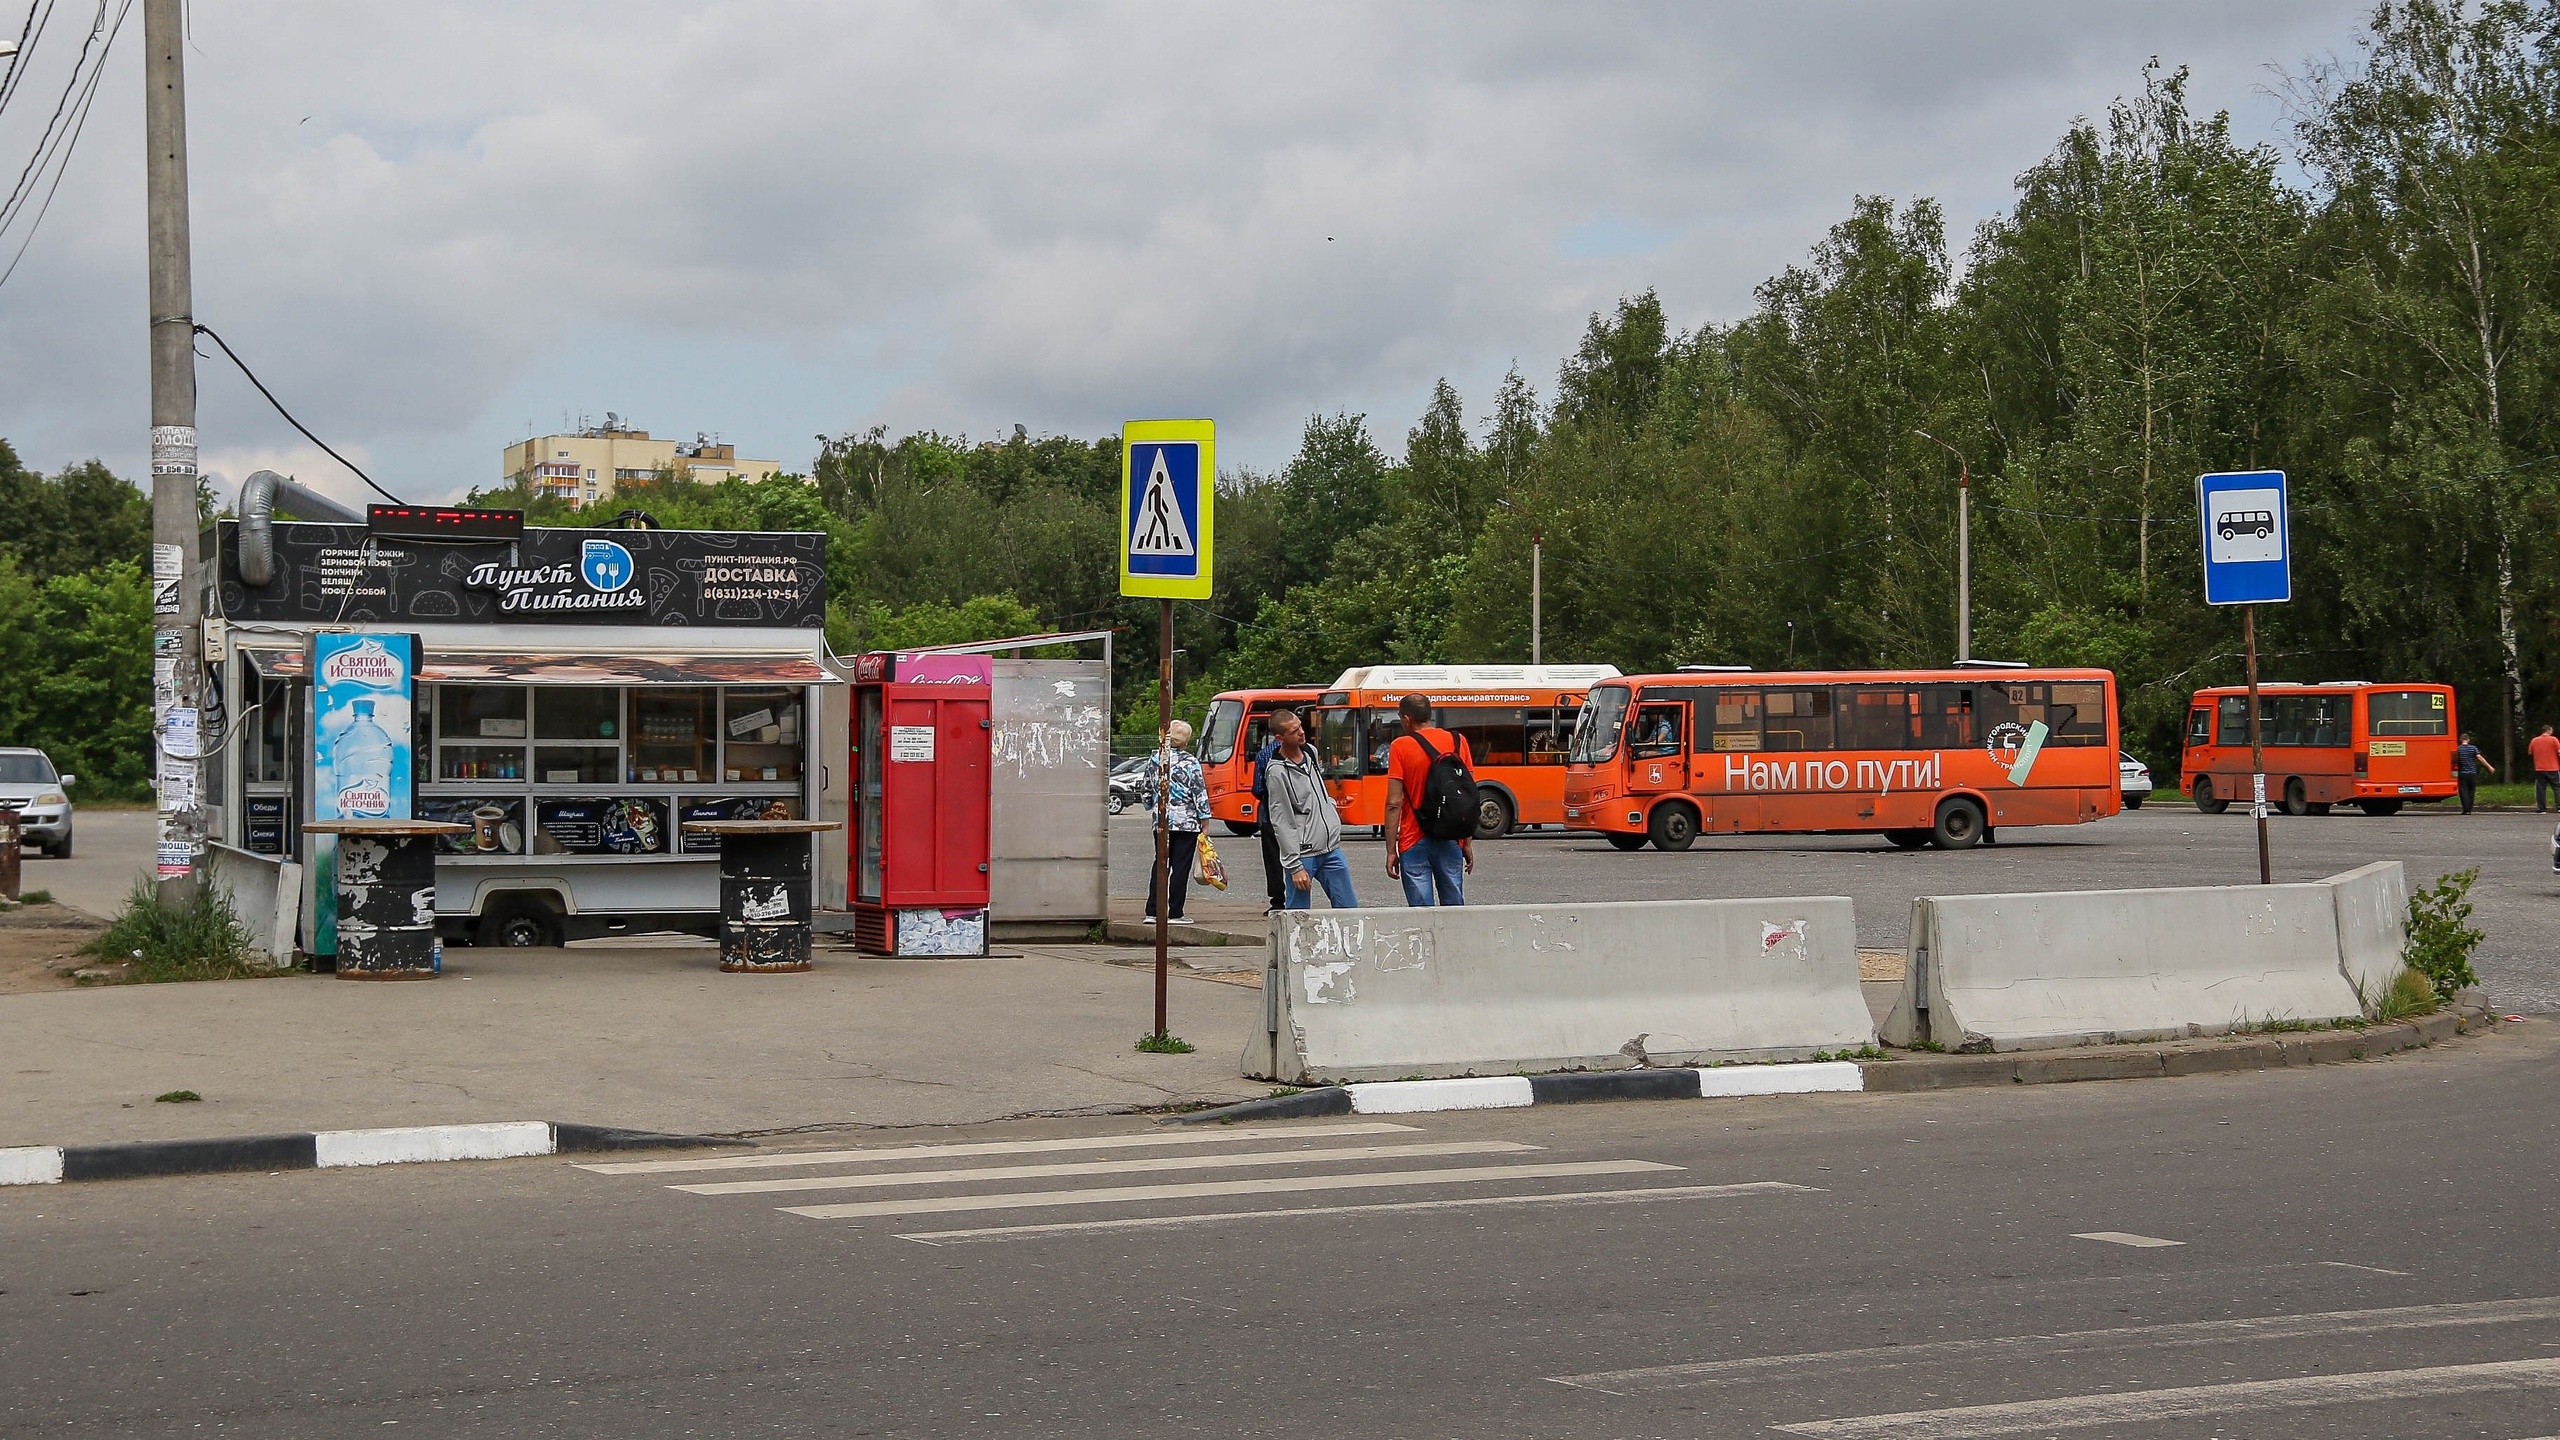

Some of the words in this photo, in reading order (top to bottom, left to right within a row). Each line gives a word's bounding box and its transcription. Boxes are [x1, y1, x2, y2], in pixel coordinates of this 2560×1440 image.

[321, 549, 359, 557] ГОРЯЧИЕ
[362, 550, 404, 558] ПОЖКИ
[321, 558, 366, 567] ЗЕРНОВОЙ
[704, 555, 798, 565] ПУНКТ-ПИТАНИЯ.РФ
[466, 562, 577, 591] Пункт
[704, 567, 798, 584] ДОСТАВКА
[356, 587, 387, 596] СОБОЙ
[704, 586, 799, 601] 8(831)234-19-54
[501, 587, 647, 611] Питания
[1381, 693, 1531, 704] «Ниждпассажиравтотранс»
[2012, 689, 2024, 701] 82
[1714, 739, 1727, 748] 82
[1725, 754, 1797, 791] Нам
[1805, 760, 1849, 790] по
[1856, 752, 1942, 797] пути!
[253, 803, 278, 812] Обеды
[252, 830, 275, 838] Снеки
